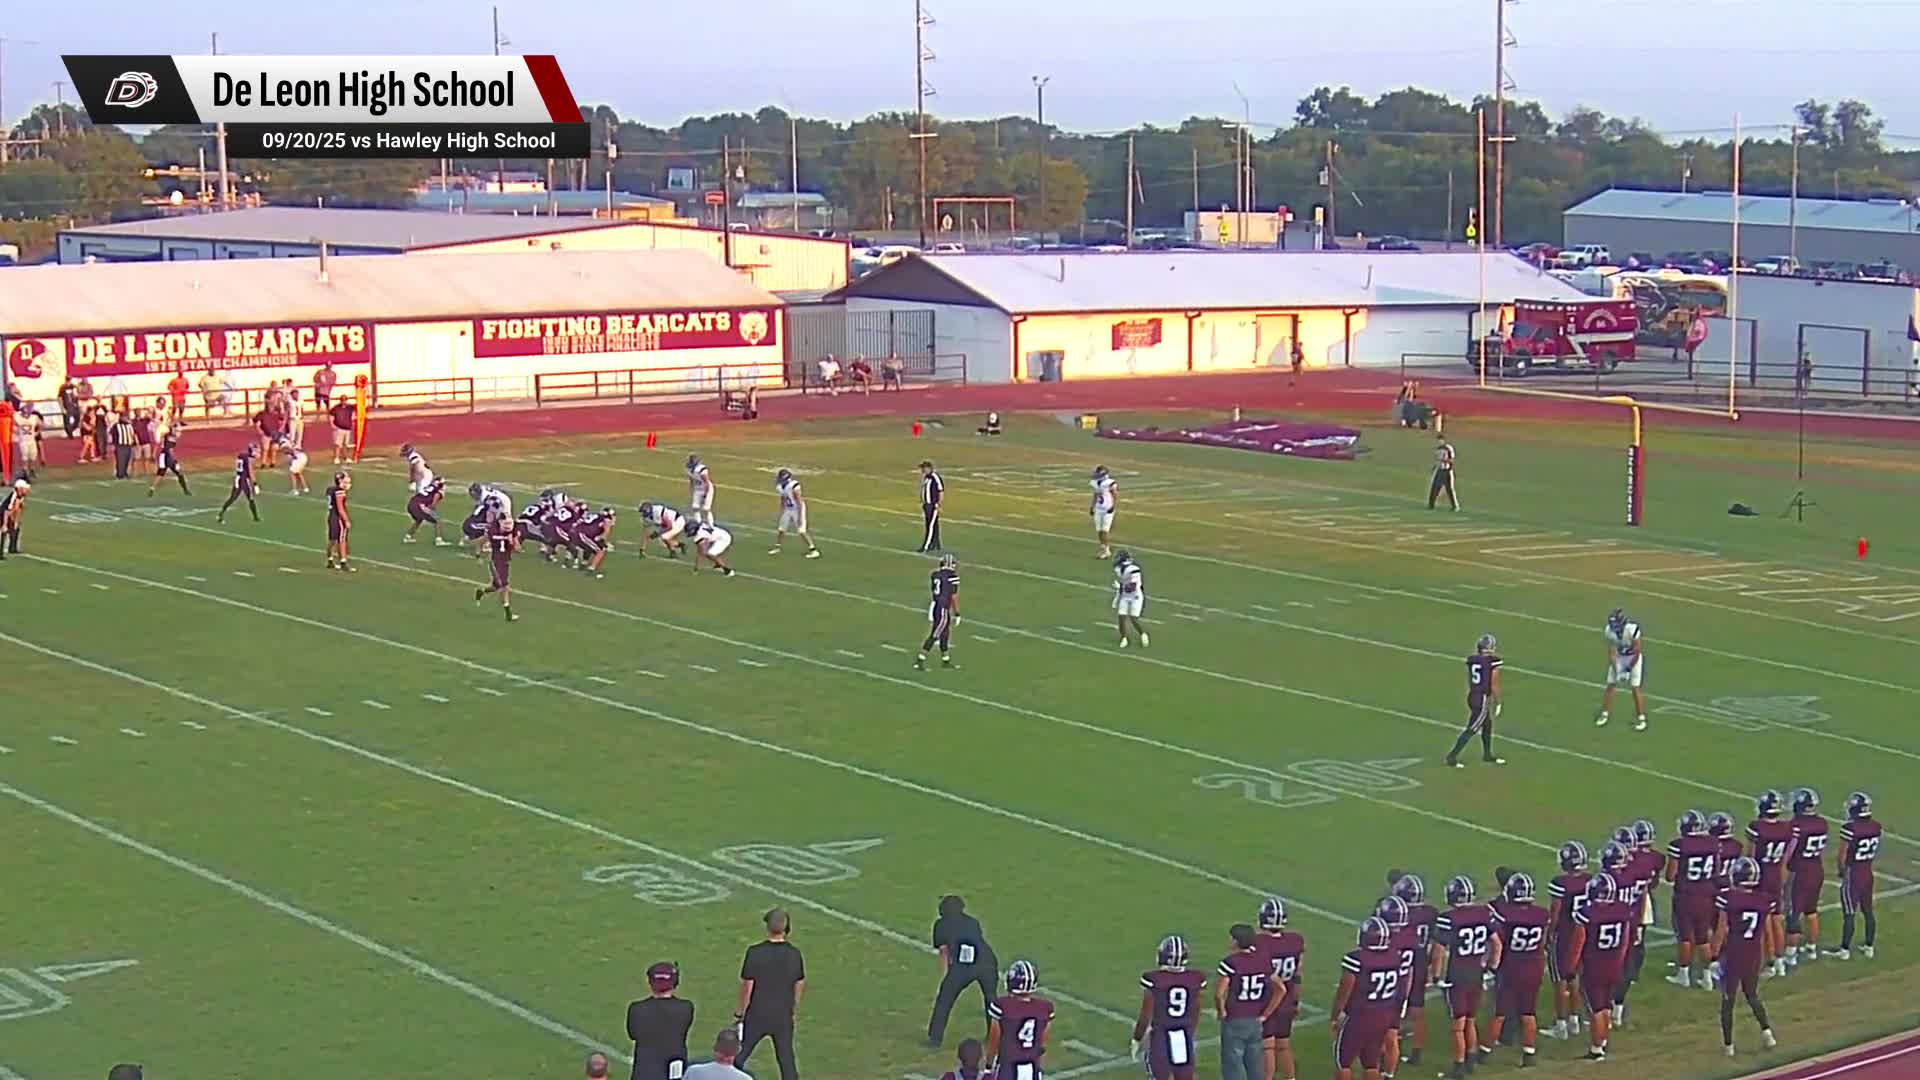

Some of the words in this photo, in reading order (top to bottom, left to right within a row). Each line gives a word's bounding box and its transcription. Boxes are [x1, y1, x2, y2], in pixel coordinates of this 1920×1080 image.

[482, 319, 600, 340] FIGHTING
[606, 312, 731, 334] BEARCATS
[73, 337, 116, 365] DE
[124, 332, 210, 362] LEON
[225, 326, 365, 358] BEARCATS
[180, 359, 221, 371] STATE
[223, 355, 298, 369] CHAMPIONS
[934, 578, 941, 595] 3
[1471, 664, 1482, 684] 5
[1761, 841, 1786, 864] 14
[1687, 855, 1714, 881] 54
[1598, 922, 1623, 949] 51
[1742, 911, 1759, 939] 7
[1458, 925, 1488, 956] 32
[1511, 926, 1542, 952] 62
[1238, 974, 1265, 1000] 15
[1368, 970, 1397, 1000] 72
[1168, 987, 1188, 1017] 9
[1018, 1019, 1036, 1048] 4
